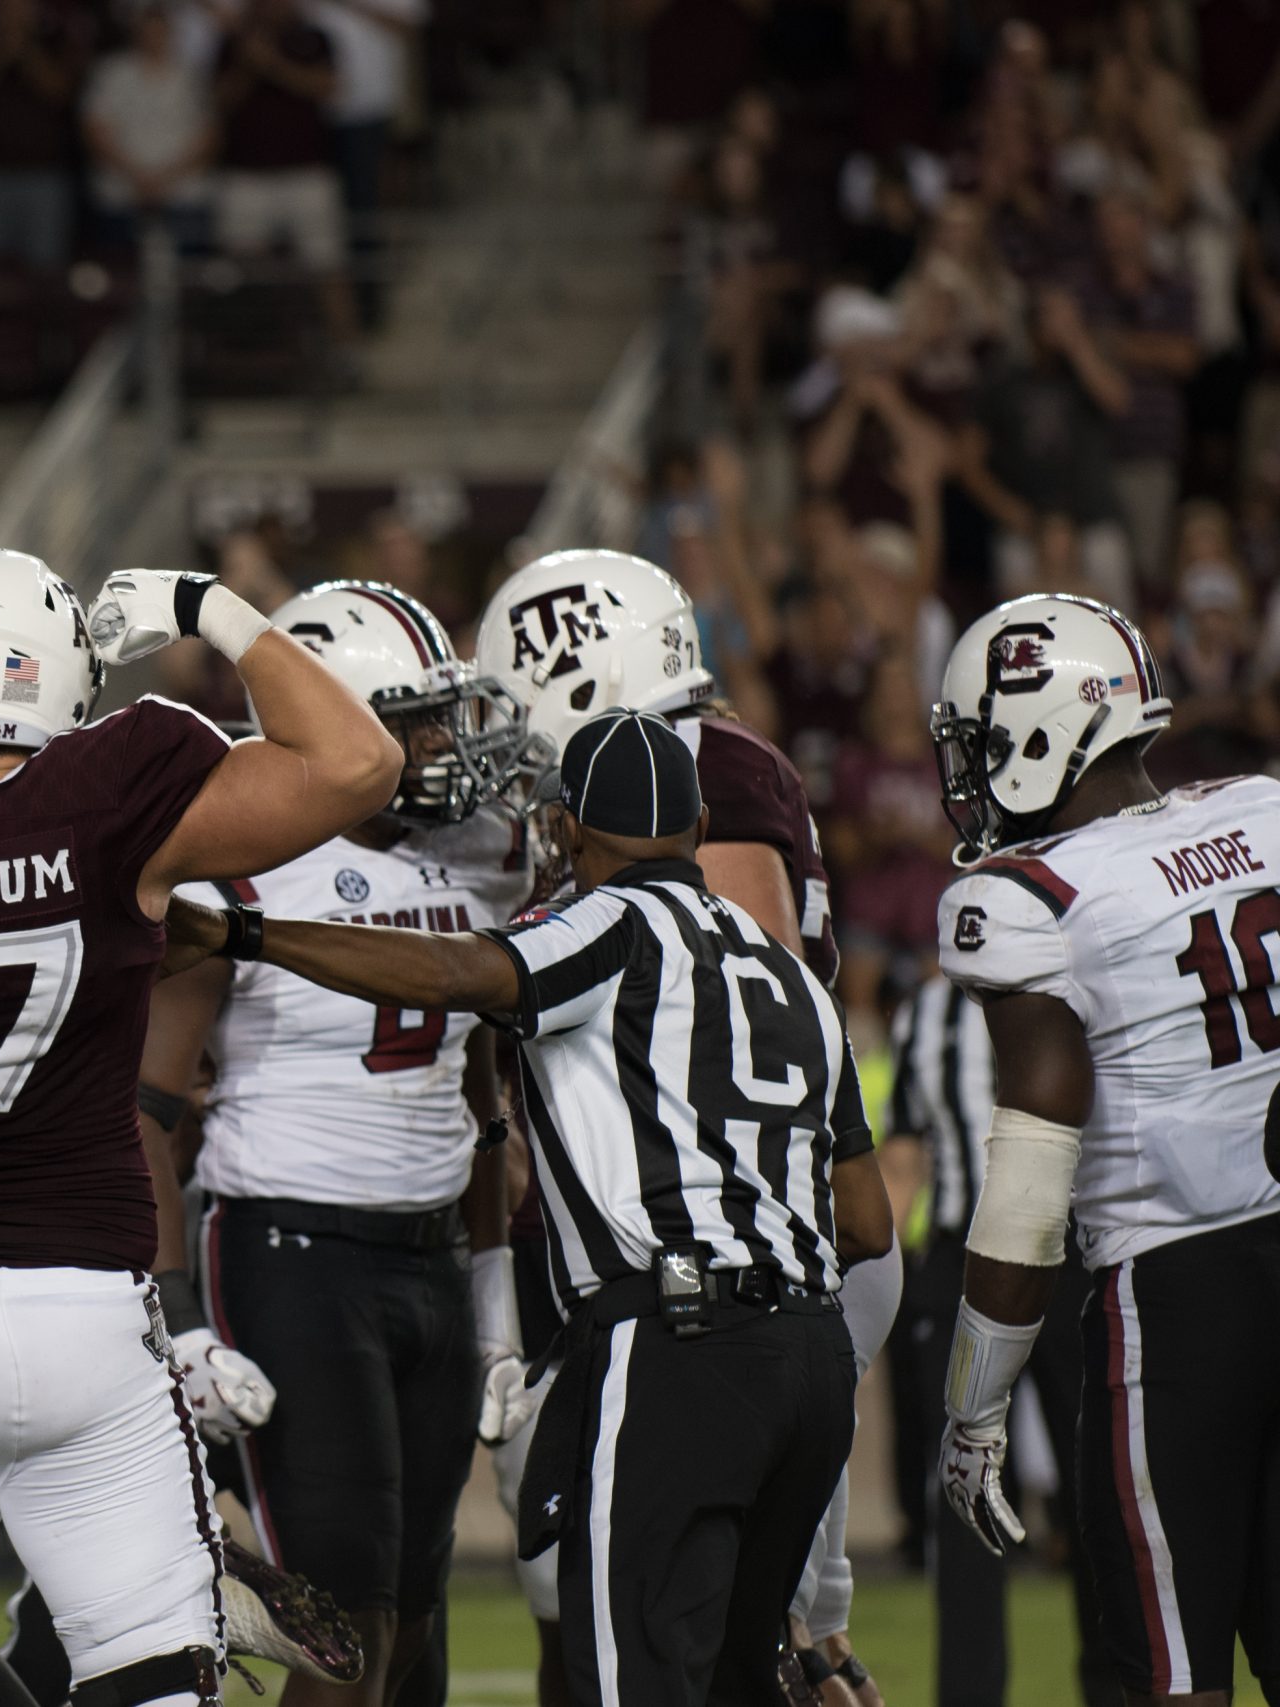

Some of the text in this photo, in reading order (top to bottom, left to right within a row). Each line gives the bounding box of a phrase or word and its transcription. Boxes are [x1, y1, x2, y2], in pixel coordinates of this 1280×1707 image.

[1080, 677, 1107, 705] SEC
[1152, 830, 1266, 897] MOORE
[328, 905, 473, 932] OLINA
[721, 952, 808, 1107] C
